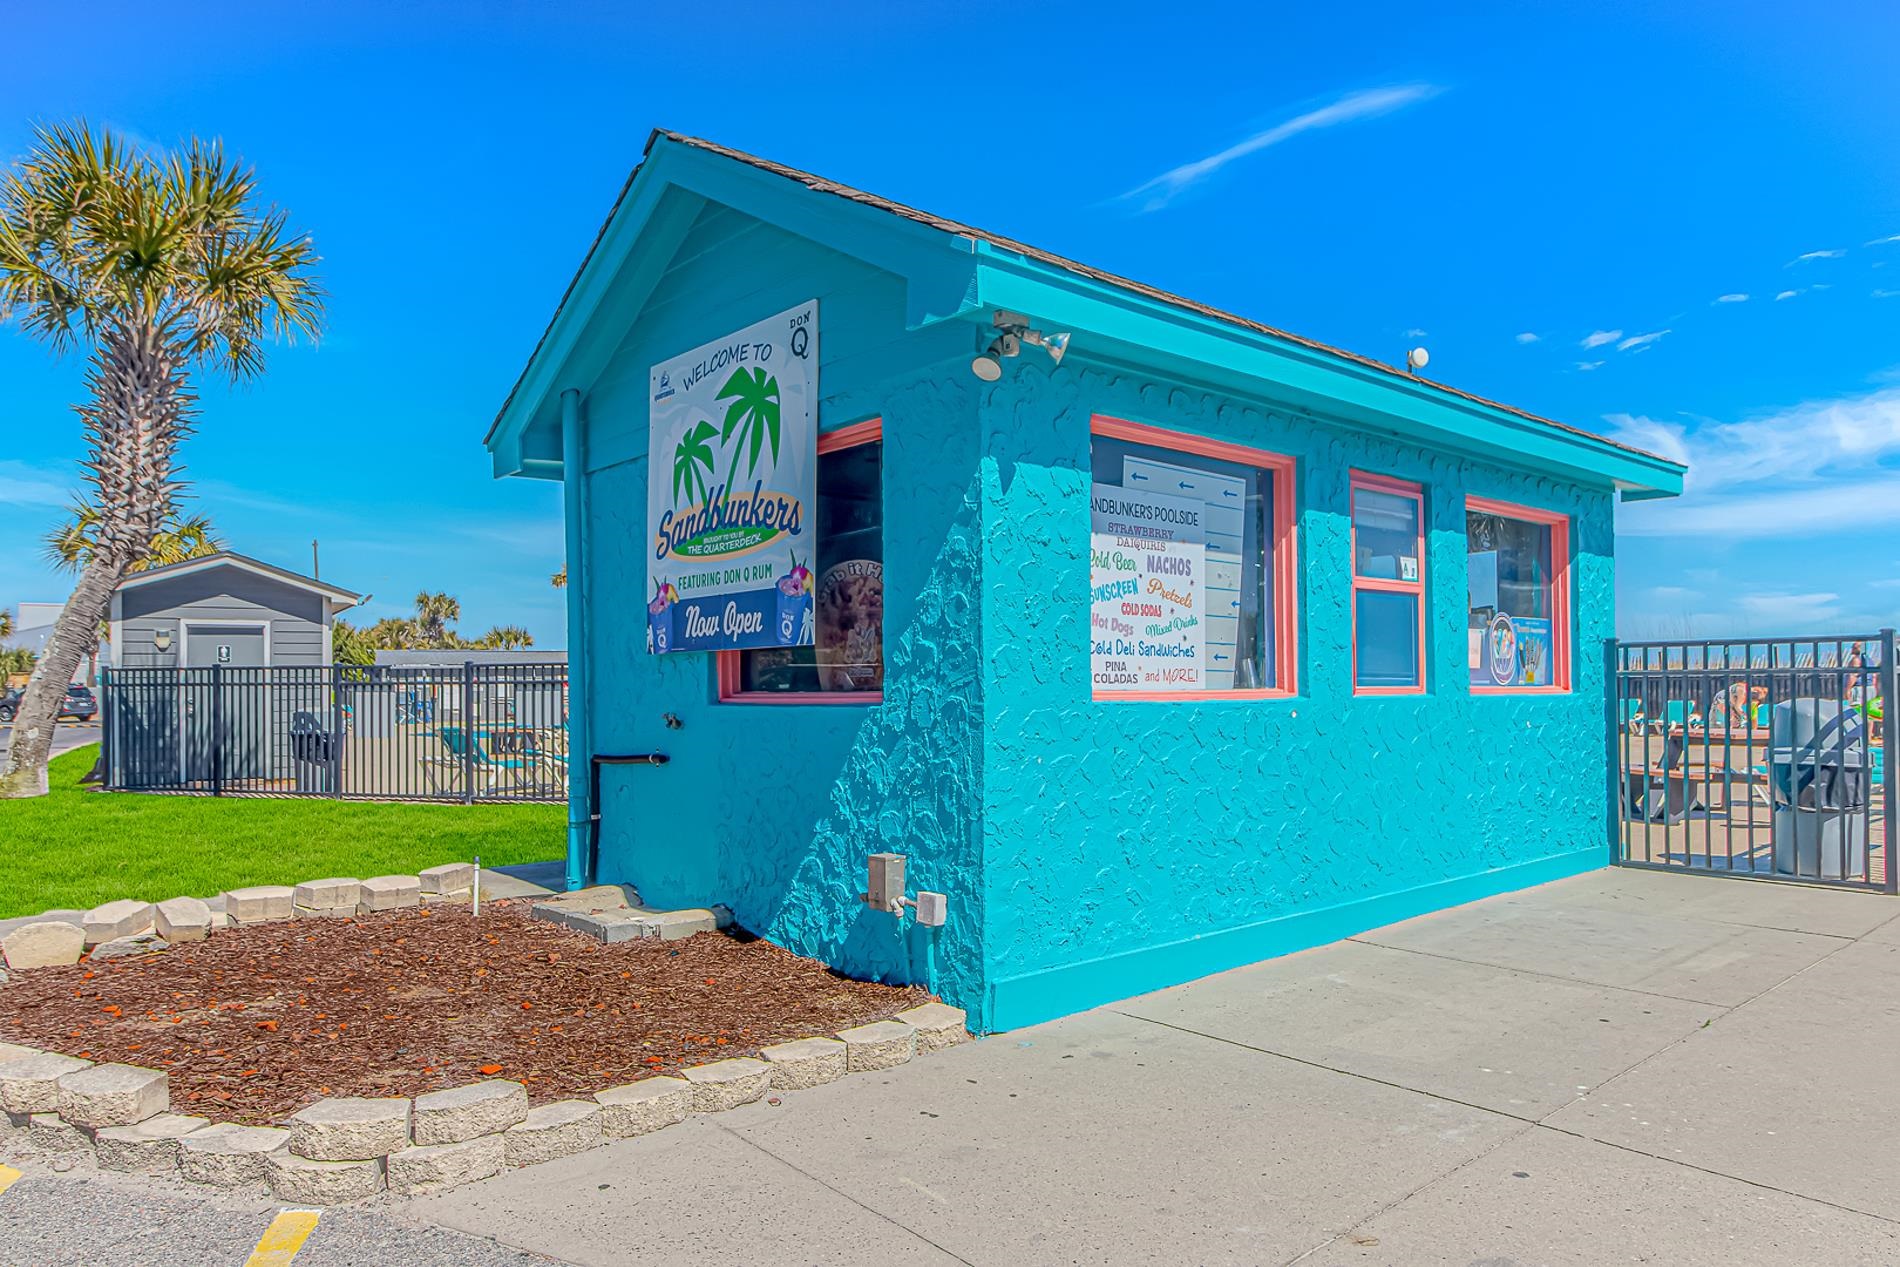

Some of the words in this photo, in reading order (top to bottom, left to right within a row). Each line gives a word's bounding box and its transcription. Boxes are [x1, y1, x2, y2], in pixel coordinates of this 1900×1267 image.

[790, 311, 811, 328] DON
[791, 327, 809, 360] Q
[683, 343, 750, 391] WELCOME
[753, 344, 772, 361] TO
[656, 480, 801, 560] Sandbunkers
[1090, 496, 1153, 520] ANDBUNKER'S
[1154, 506, 1199, 526] POOLSIDE
[1108, 522, 1174, 540] STRAWBERRY
[688, 545, 703, 555] THE
[703, 532, 762, 554] QUARTERDECK
[1116, 537, 1166, 552] DAIQUIRIS
[1112, 551, 1137, 571] Beer
[1146, 554, 1192, 577] NACHOS
[678, 571, 721, 590] FEATURING
[724, 567, 741, 584] DON
[744, 567, 750, 582] Q
[752, 563, 773, 580] RUM
[1090, 577, 1139, 605] SUNSCREEN
[1146, 578, 1192, 609] Pretzels
[685, 605, 720, 638] Now
[723, 600, 763, 642] Open
[1121, 602, 1139, 616] COLD
[1140, 603, 1162, 618] SODAS
[781, 620, 793, 639] Q
[1092, 612, 1108, 629] Hot
[1111, 617, 1134, 637] Dogs
[1145, 621, 1173, 638] Mixed
[1173, 615, 1198, 631] Drinks
[657, 634, 667, 649] Q
[1090, 640, 1113, 656] Cold
[1115, 638, 1135, 656] Deli
[1138, 640, 1195, 658] Sandwiches
[1105, 661, 1127, 672] PINA
[1144, 668, 1160, 682] and
[1162, 668, 1199, 685] MORE!
[1093, 673, 1139, 684] COLADAS
